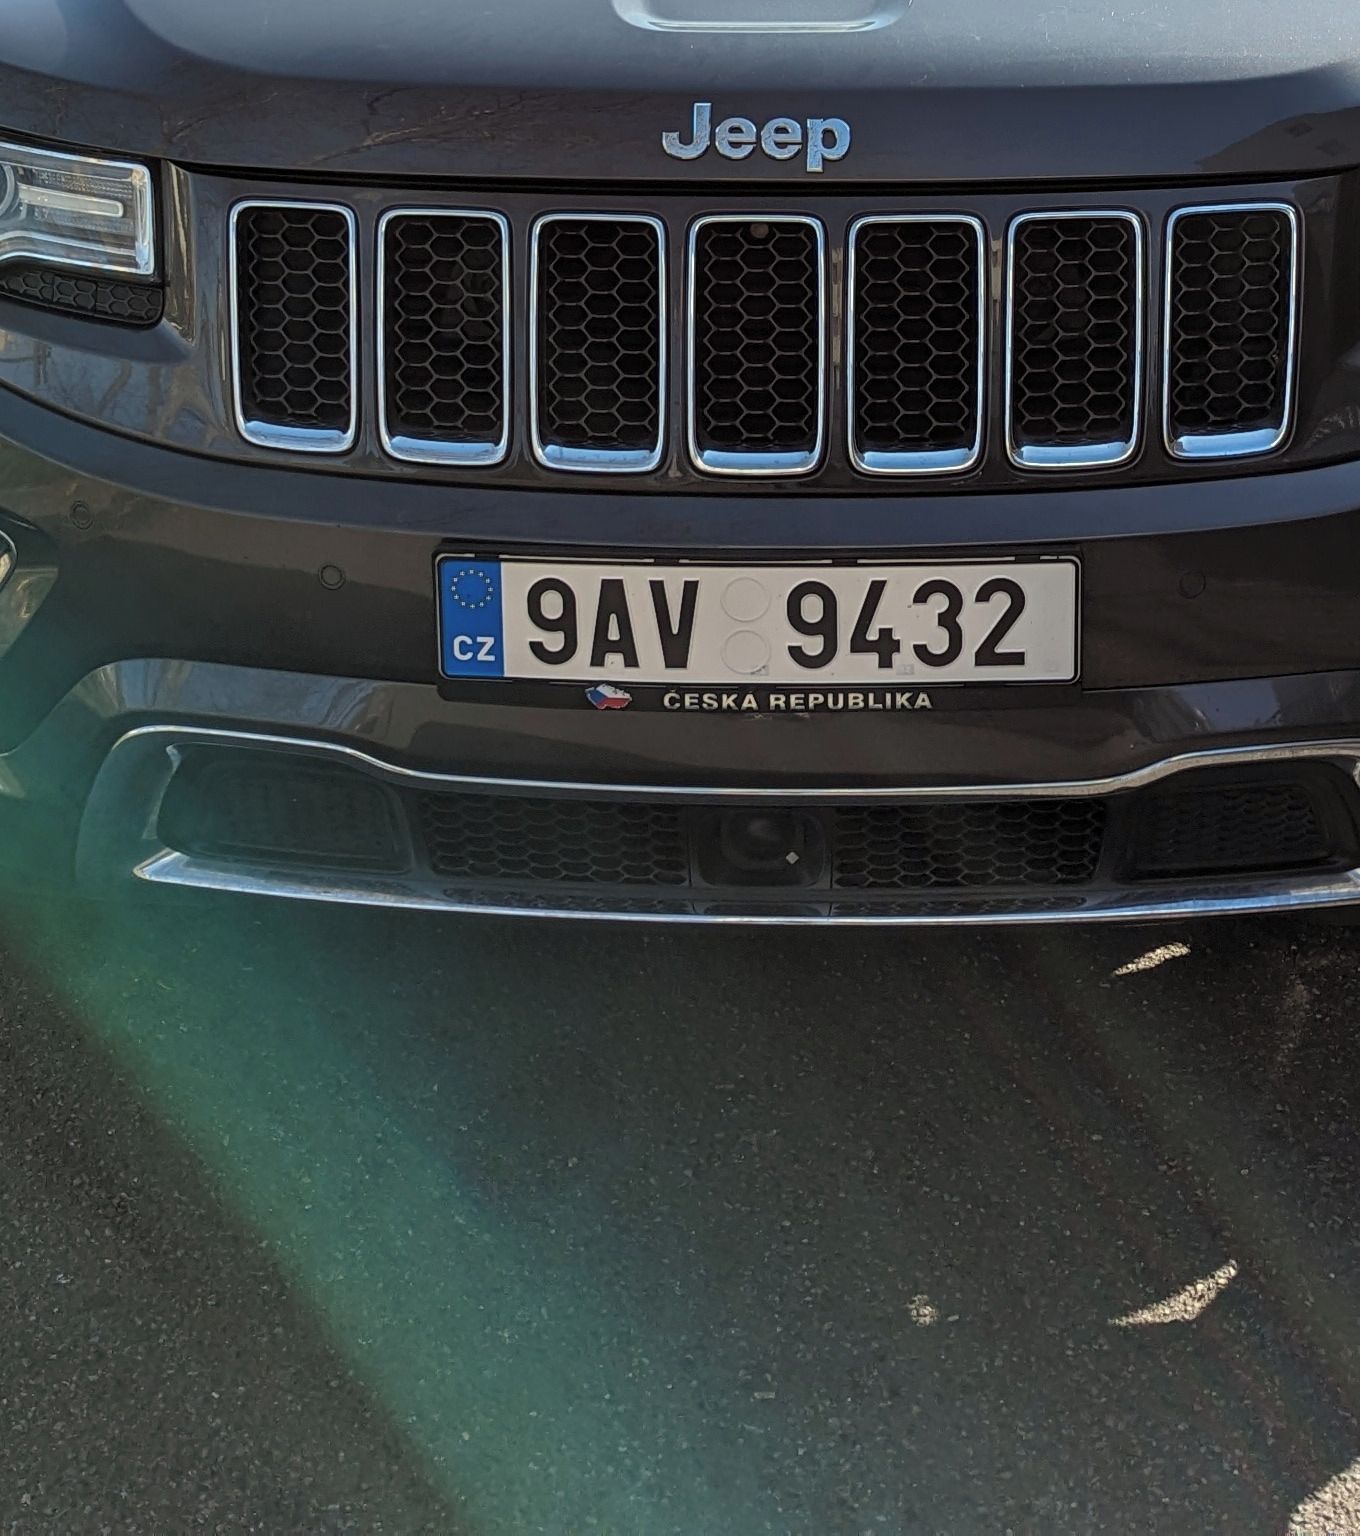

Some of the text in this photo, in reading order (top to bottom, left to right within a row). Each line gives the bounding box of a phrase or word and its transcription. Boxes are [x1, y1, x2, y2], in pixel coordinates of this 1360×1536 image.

[662, 102, 851, 173] Jeep
[526, 577, 1026, 670] 9AV 9432
[452, 635, 497, 662] CZ
[663, 689, 933, 710] ČESKÁ REPUBLIKA
